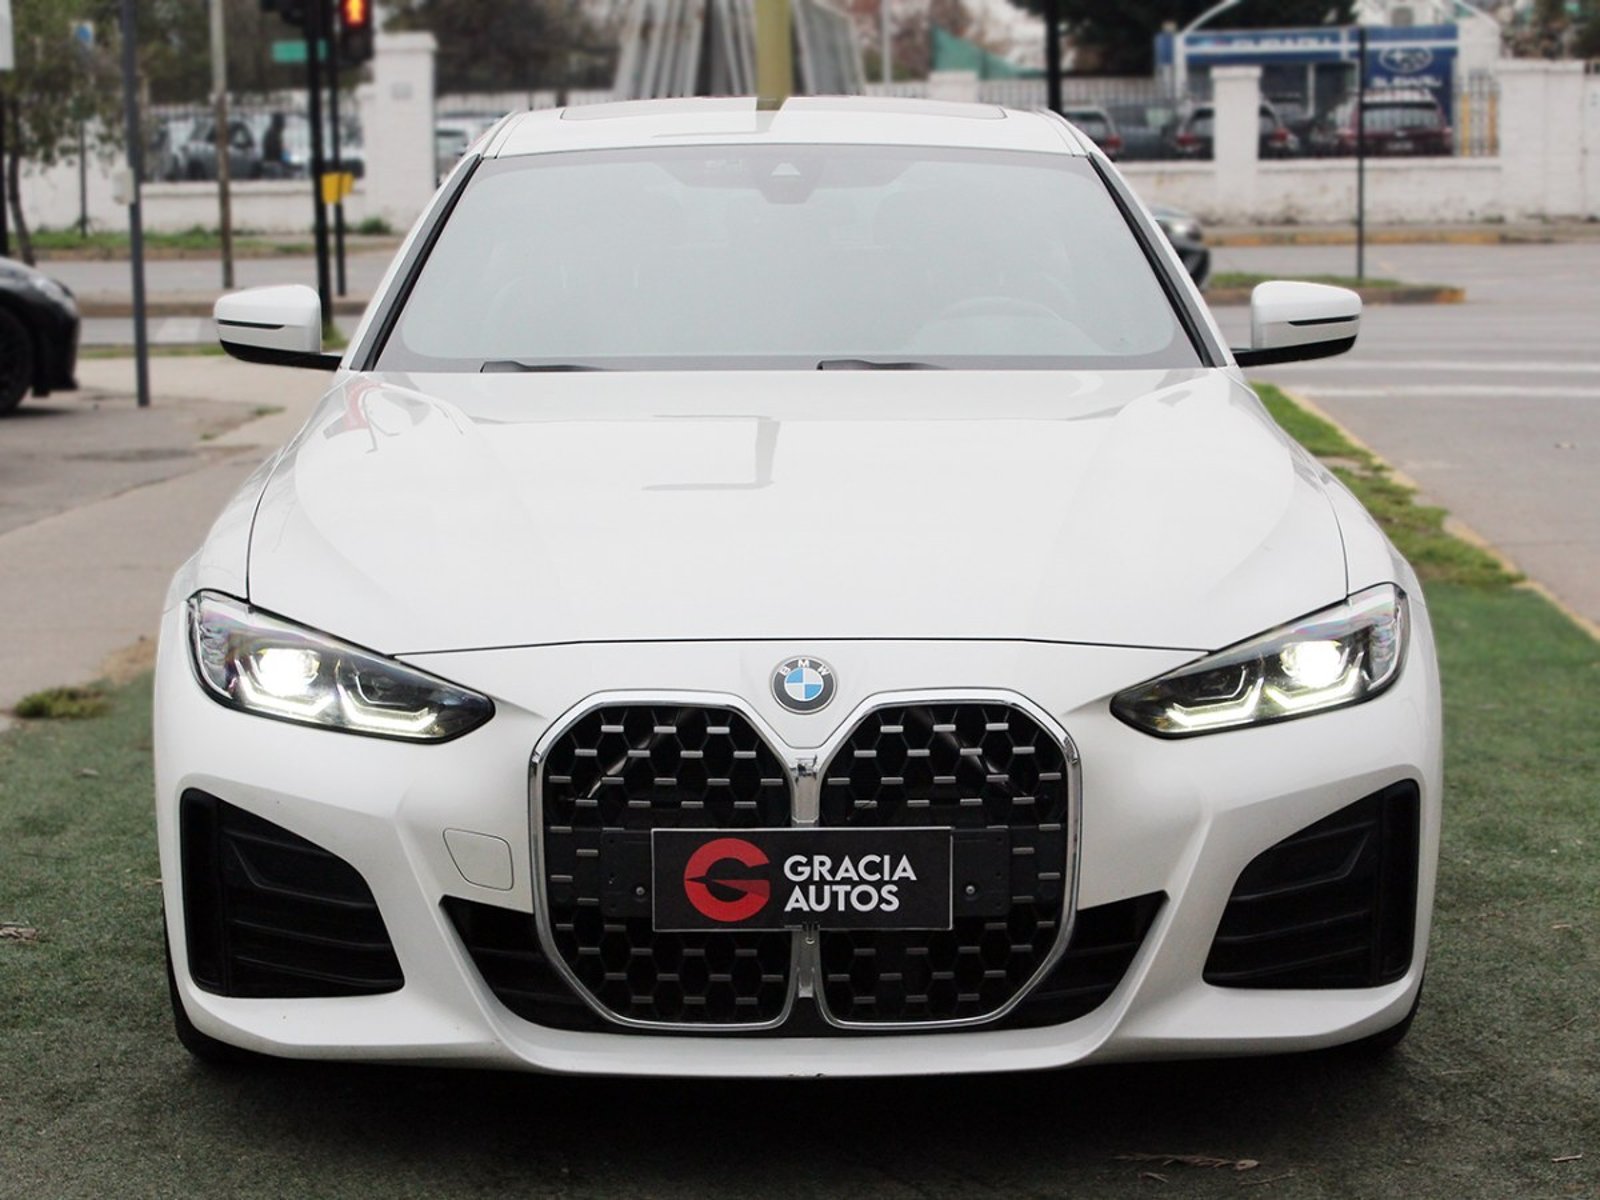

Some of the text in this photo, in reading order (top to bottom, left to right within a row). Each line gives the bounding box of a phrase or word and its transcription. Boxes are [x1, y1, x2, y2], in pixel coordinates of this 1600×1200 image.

[779, 659, 831, 676] BMW
[783, 854, 917, 882] GRACIA
[784, 884, 900, 912] AUTOS
